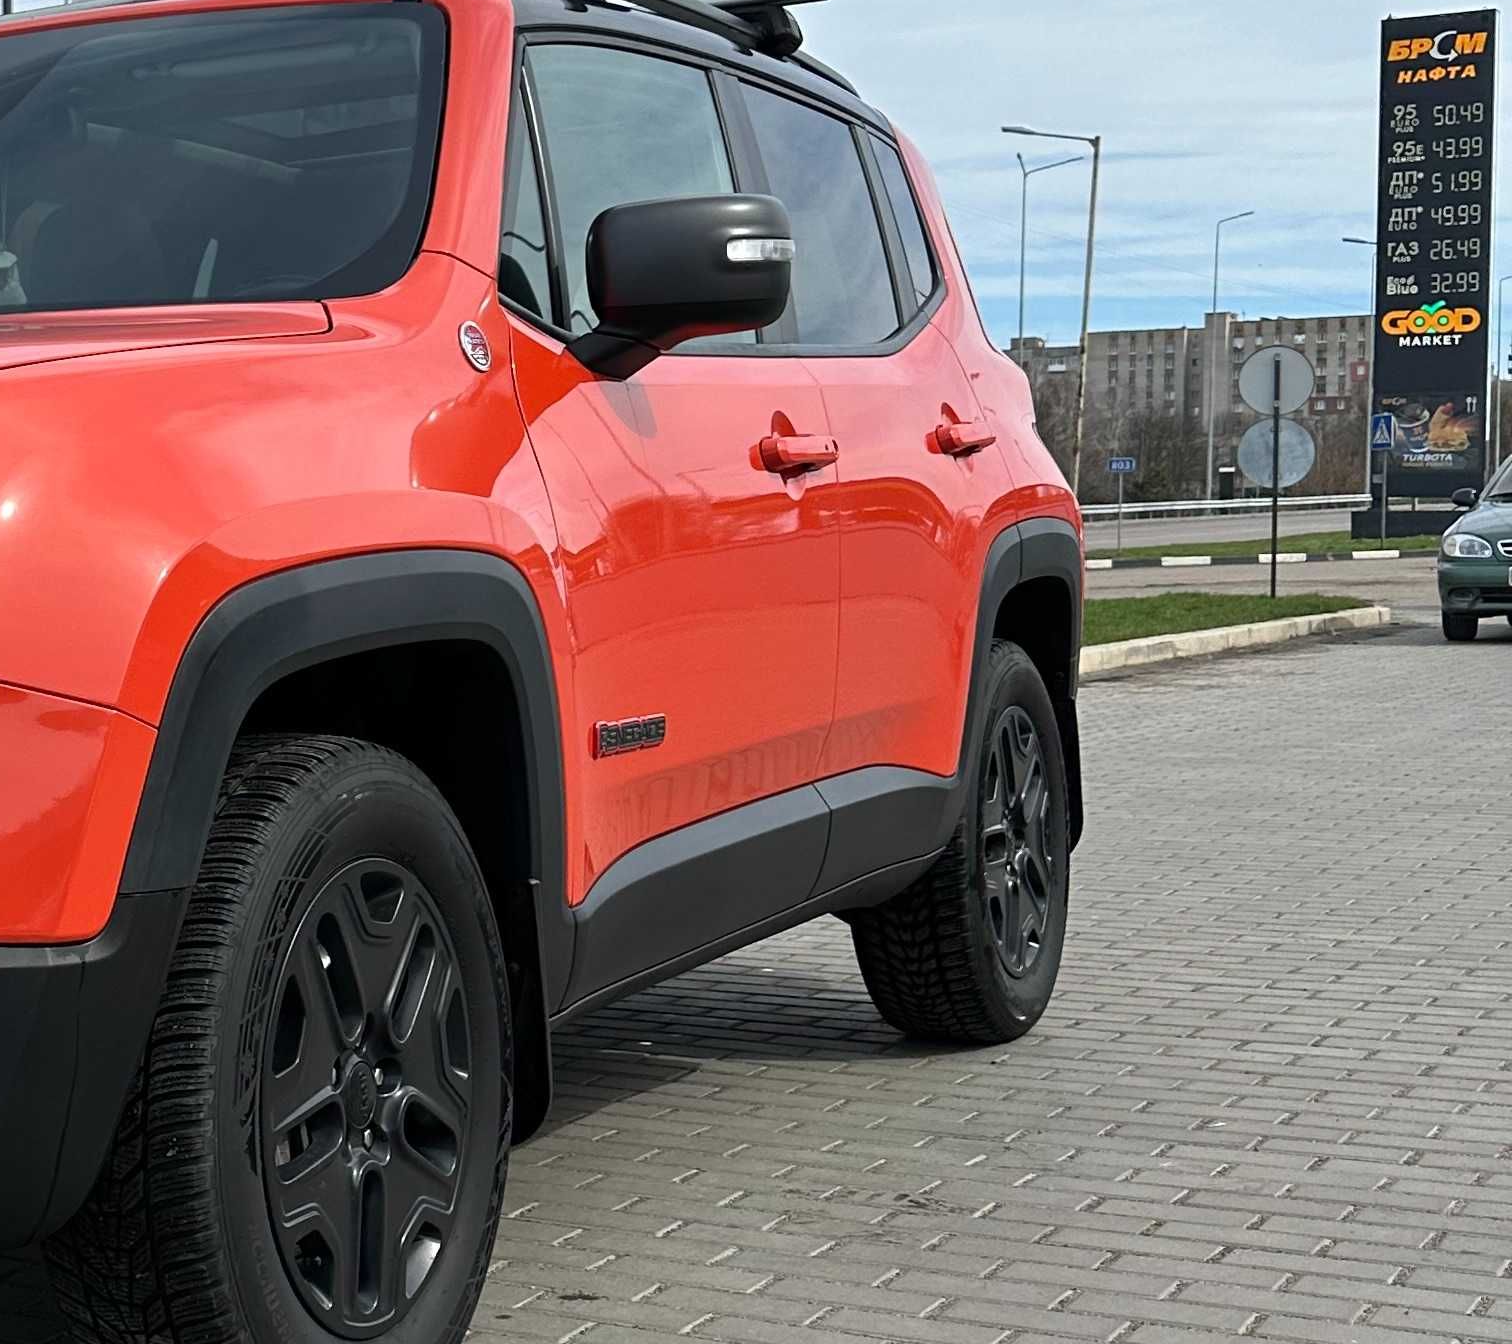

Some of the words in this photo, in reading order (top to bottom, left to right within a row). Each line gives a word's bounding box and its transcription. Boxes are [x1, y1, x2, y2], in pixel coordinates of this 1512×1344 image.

[1387, 30, 1488, 62] БРСМ
[1397, 64, 1477, 84] НАФТА
[1390, 118, 1420, 128] EURO
[1393, 103, 1417, 121] 95
[1432, 102, 1484, 126] 50.49
[1432, 136, 1483, 159] 43.99
[1431, 169, 1482, 194] 51.99
[1388, 221, 1418, 231] EURO
[1431, 204, 1482, 226] 49.99
[1387, 241, 1420, 257] ГАЗ
[1430, 237, 1481, 260] 26.49
[1386, 283, 1419, 296] Blue
[1431, 271, 1480, 294] 32.99
[1381, 306, 1482, 335] GOOD
[1399, 334, 1463, 348] MARKET
